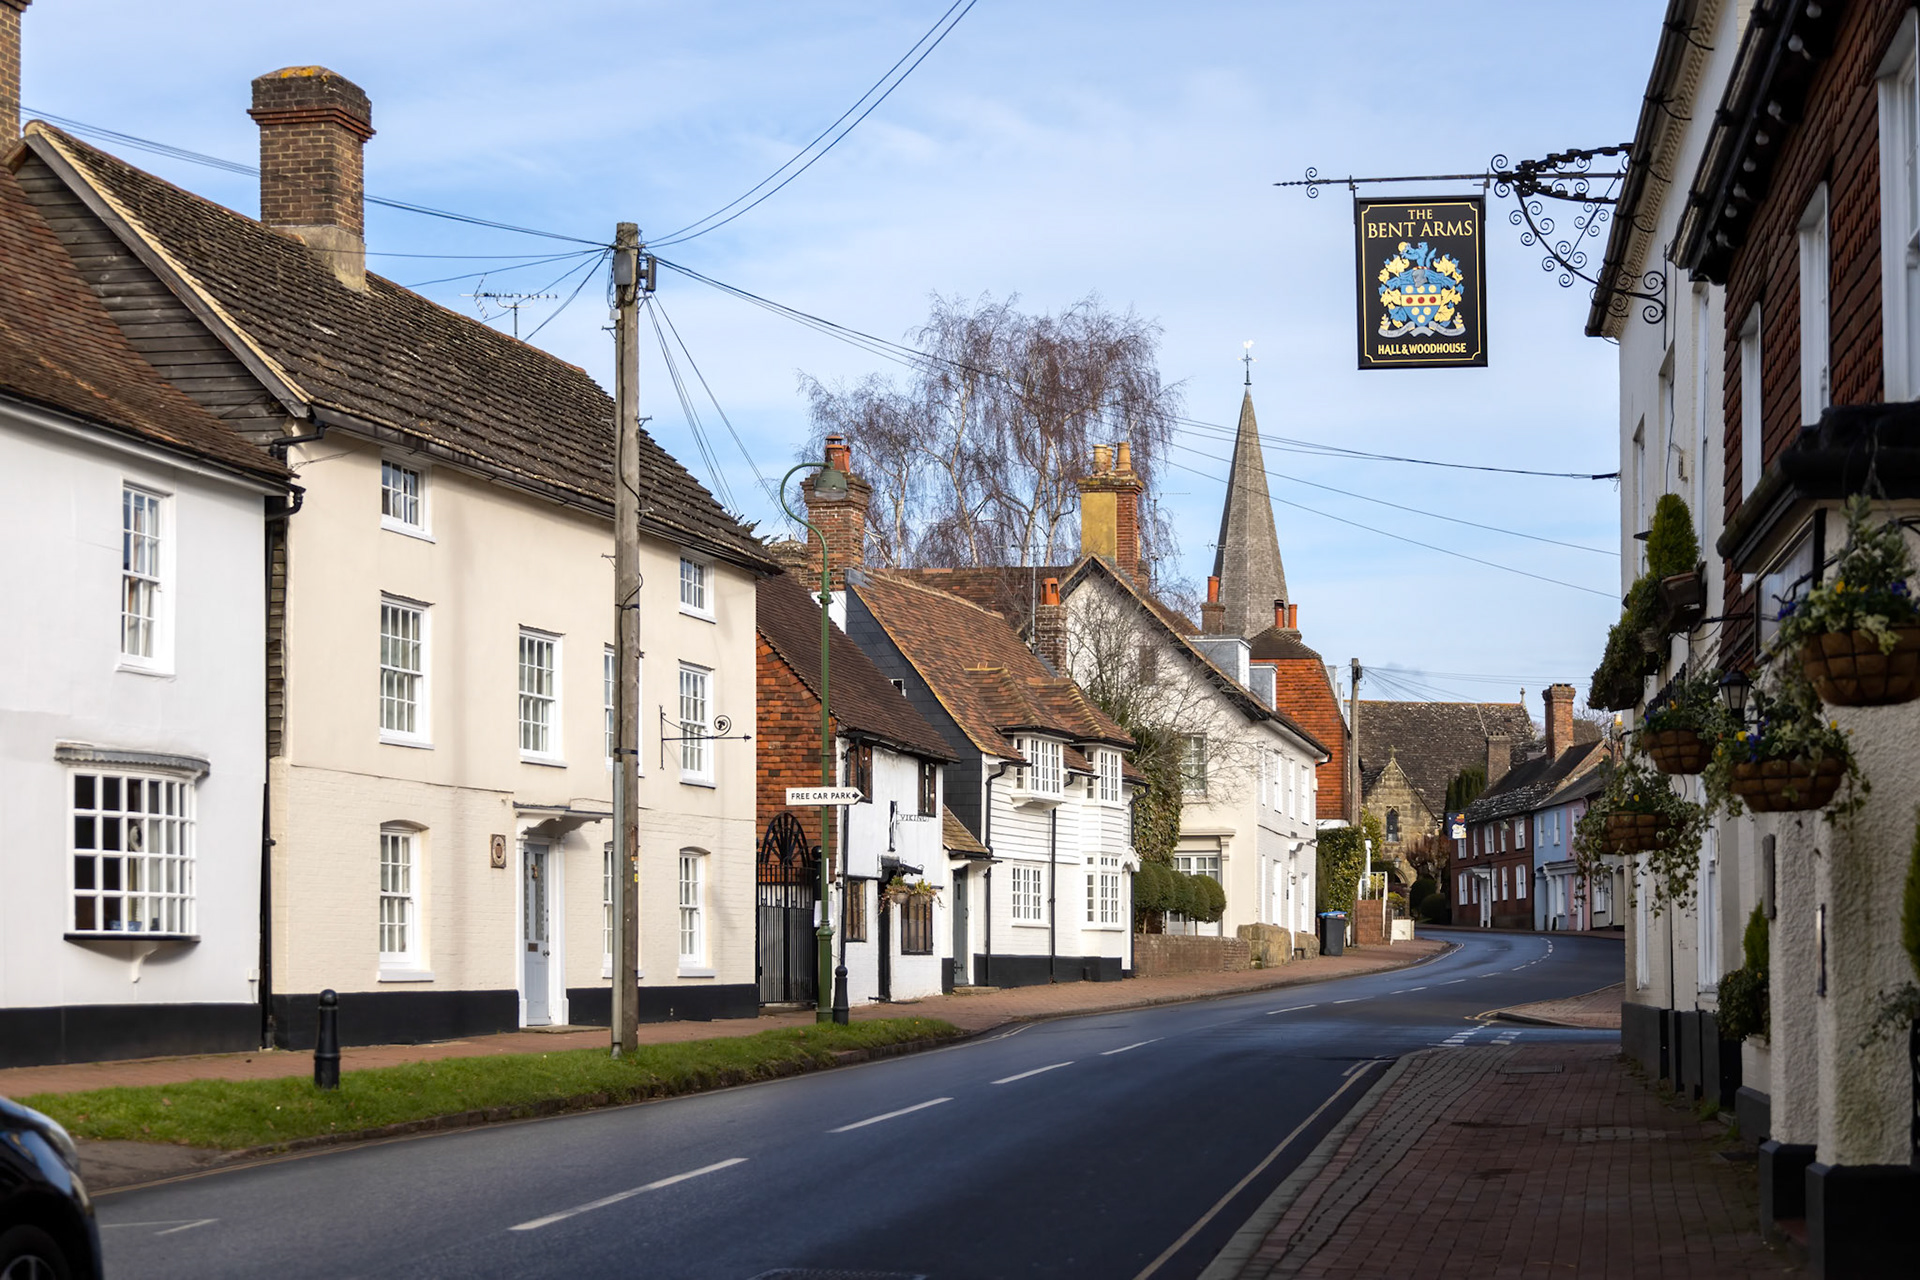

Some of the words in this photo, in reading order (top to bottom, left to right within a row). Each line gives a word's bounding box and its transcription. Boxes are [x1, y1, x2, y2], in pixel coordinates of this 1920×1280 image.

[1407, 209, 1433, 220] THE
[1367, 221, 1416, 238] BENT
[1420, 220, 1473, 237] ARMS
[791, 792, 810, 800] FREE
[812, 792, 828, 800] CAR
[830, 792, 851, 800] PARK
